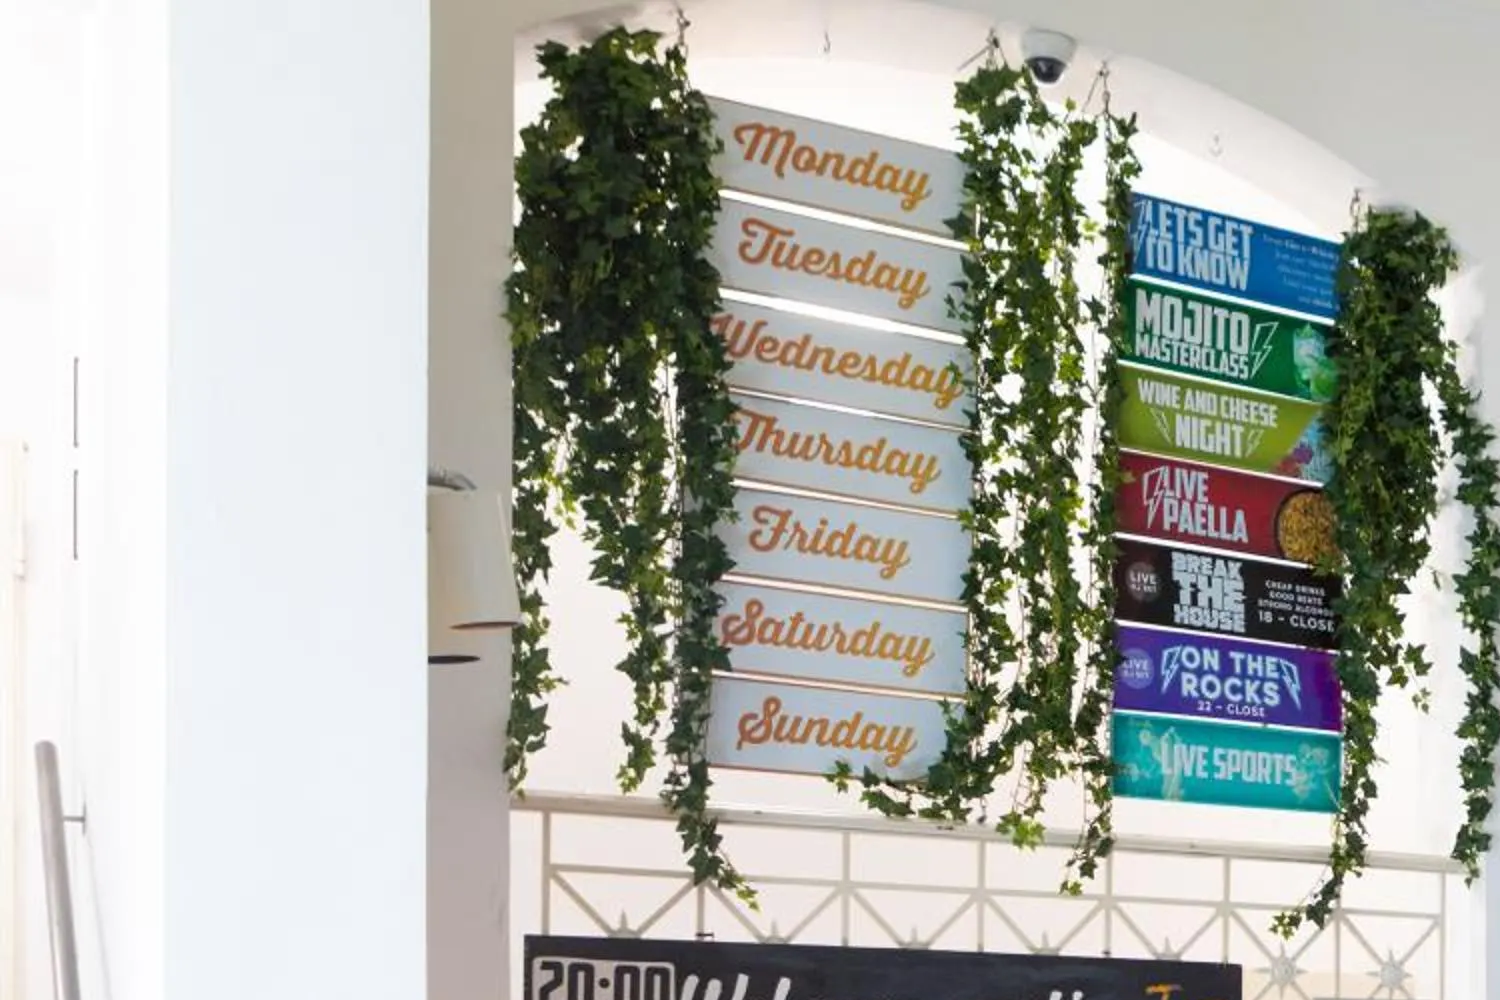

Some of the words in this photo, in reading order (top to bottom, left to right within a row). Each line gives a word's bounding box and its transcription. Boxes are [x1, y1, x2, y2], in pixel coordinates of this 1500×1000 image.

[734, 122, 931, 212] Monday
[1147, 199, 1203, 249] LETS
[1207, 216, 1252, 257] GET
[738, 218, 930, 309] Tuesday
[1145, 237, 1173, 272] TO
[1177, 243, 1249, 291] KNOW
[1136, 289, 1250, 354] MOJITO
[710, 314, 963, 409] Wednesday
[1136, 332, 1249, 380] MASTERCLASS
[1137, 377, 1181, 410] WINE
[1184, 387, 1218, 417] AND
[1220, 394, 1278, 428] CHEESE
[730, 408, 940, 494] Thursday
[1175, 415, 1245, 458] NIGHT
[1164, 465, 1209, 503] LIVE
[749, 505, 910, 580] Friday
[1163, 496, 1248, 543] PAELLA
[1171, 551, 1244, 581] BREAK
[1173, 575, 1246, 612] THE
[721, 599, 935, 677] Saturday
[1173, 603, 1246, 633] HOUSE
[1289, 614, 1335, 632] CLOSE
[1180, 646, 1220, 673] ON
[1230, 652, 1282, 679] THE
[1181, 672, 1281, 708] ROCKS
[1226, 703, 1265, 717] CLOSE
[737, 696, 917, 767] Sunday
[1161, 740, 1209, 779] LIVE
[1213, 752, 1297, 787] SPORTS
